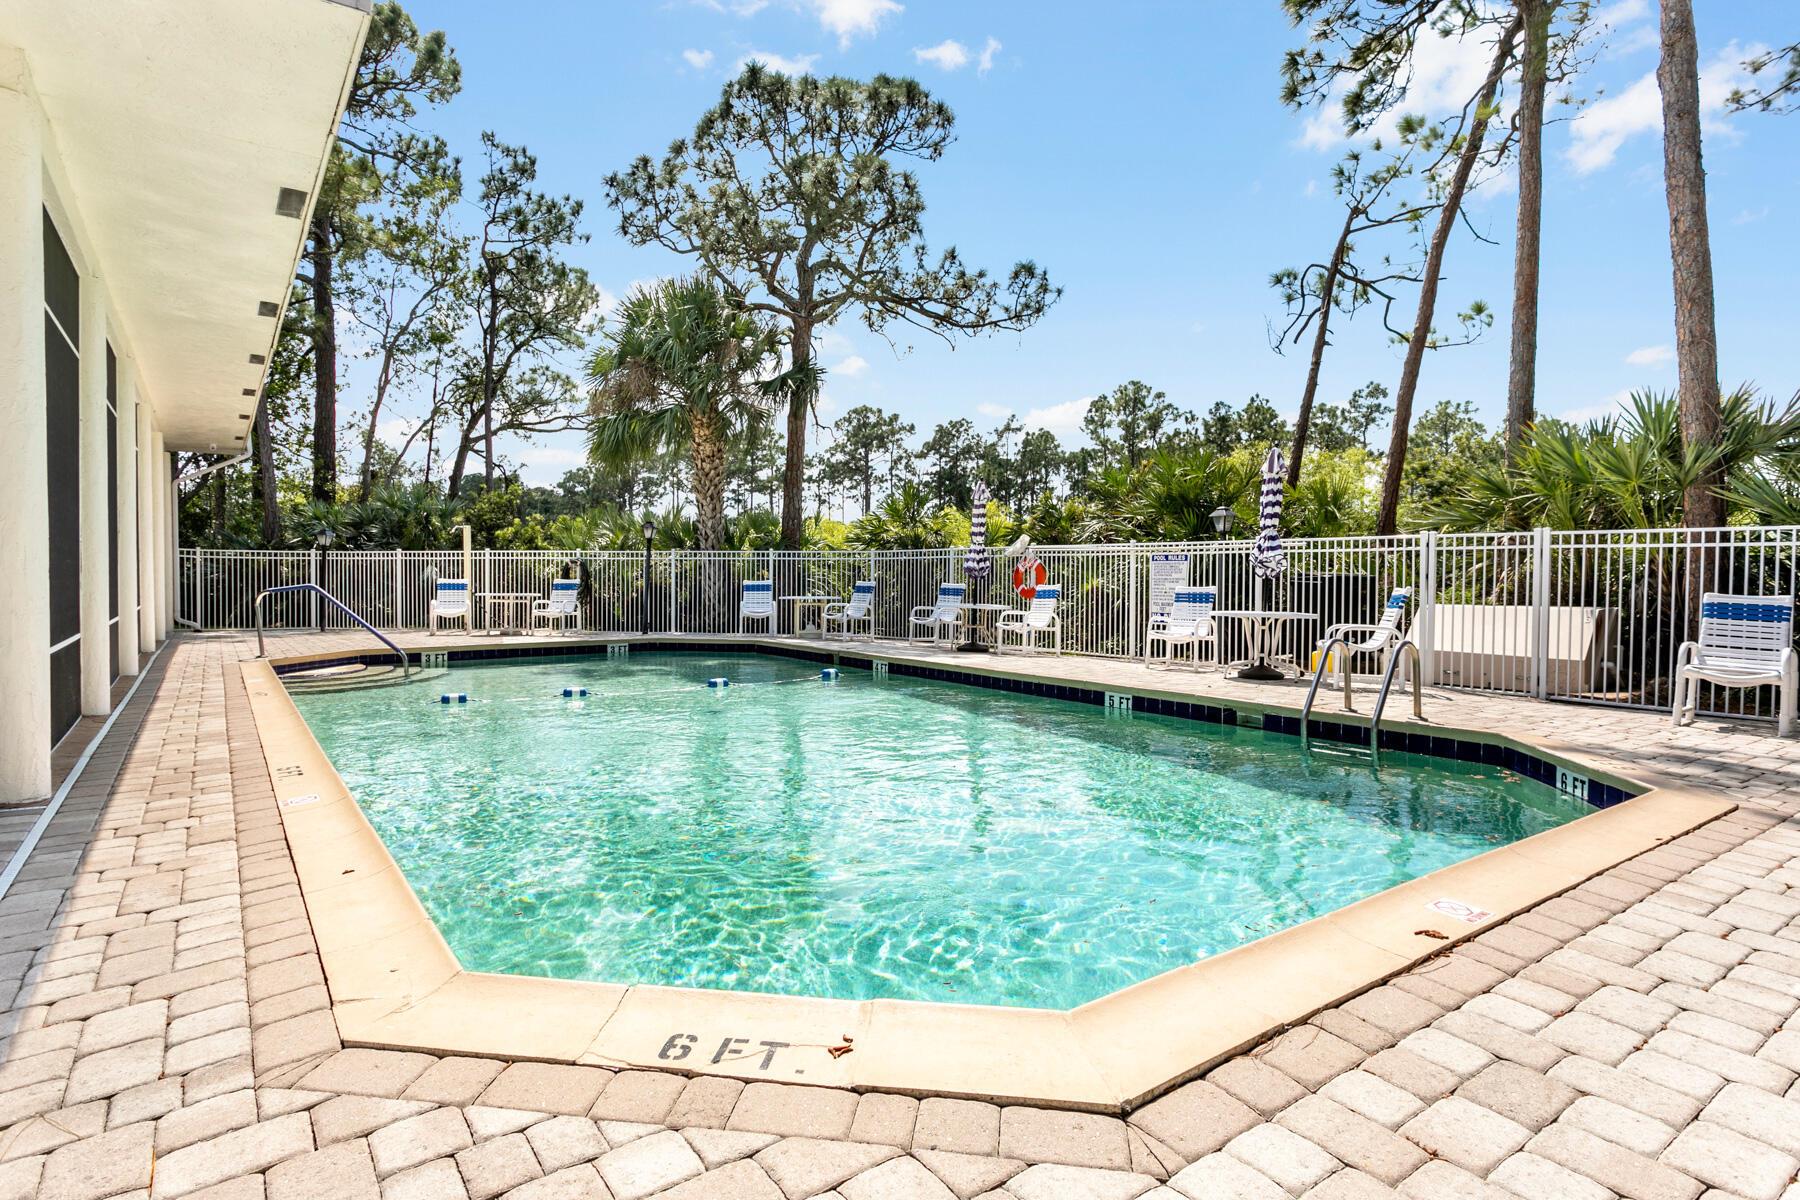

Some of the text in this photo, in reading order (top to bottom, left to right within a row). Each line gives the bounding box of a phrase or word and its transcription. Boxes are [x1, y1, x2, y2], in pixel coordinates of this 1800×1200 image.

[610, 645, 627, 653] 3 FT
[425, 653, 446, 662] 3 FT
[875, 663, 887, 672] 4 FT
[1108, 695, 1130, 709] 5 FT
[1561, 772, 1586, 797] 6 FT
[657, 1033, 805, 1074] 6 FT.
